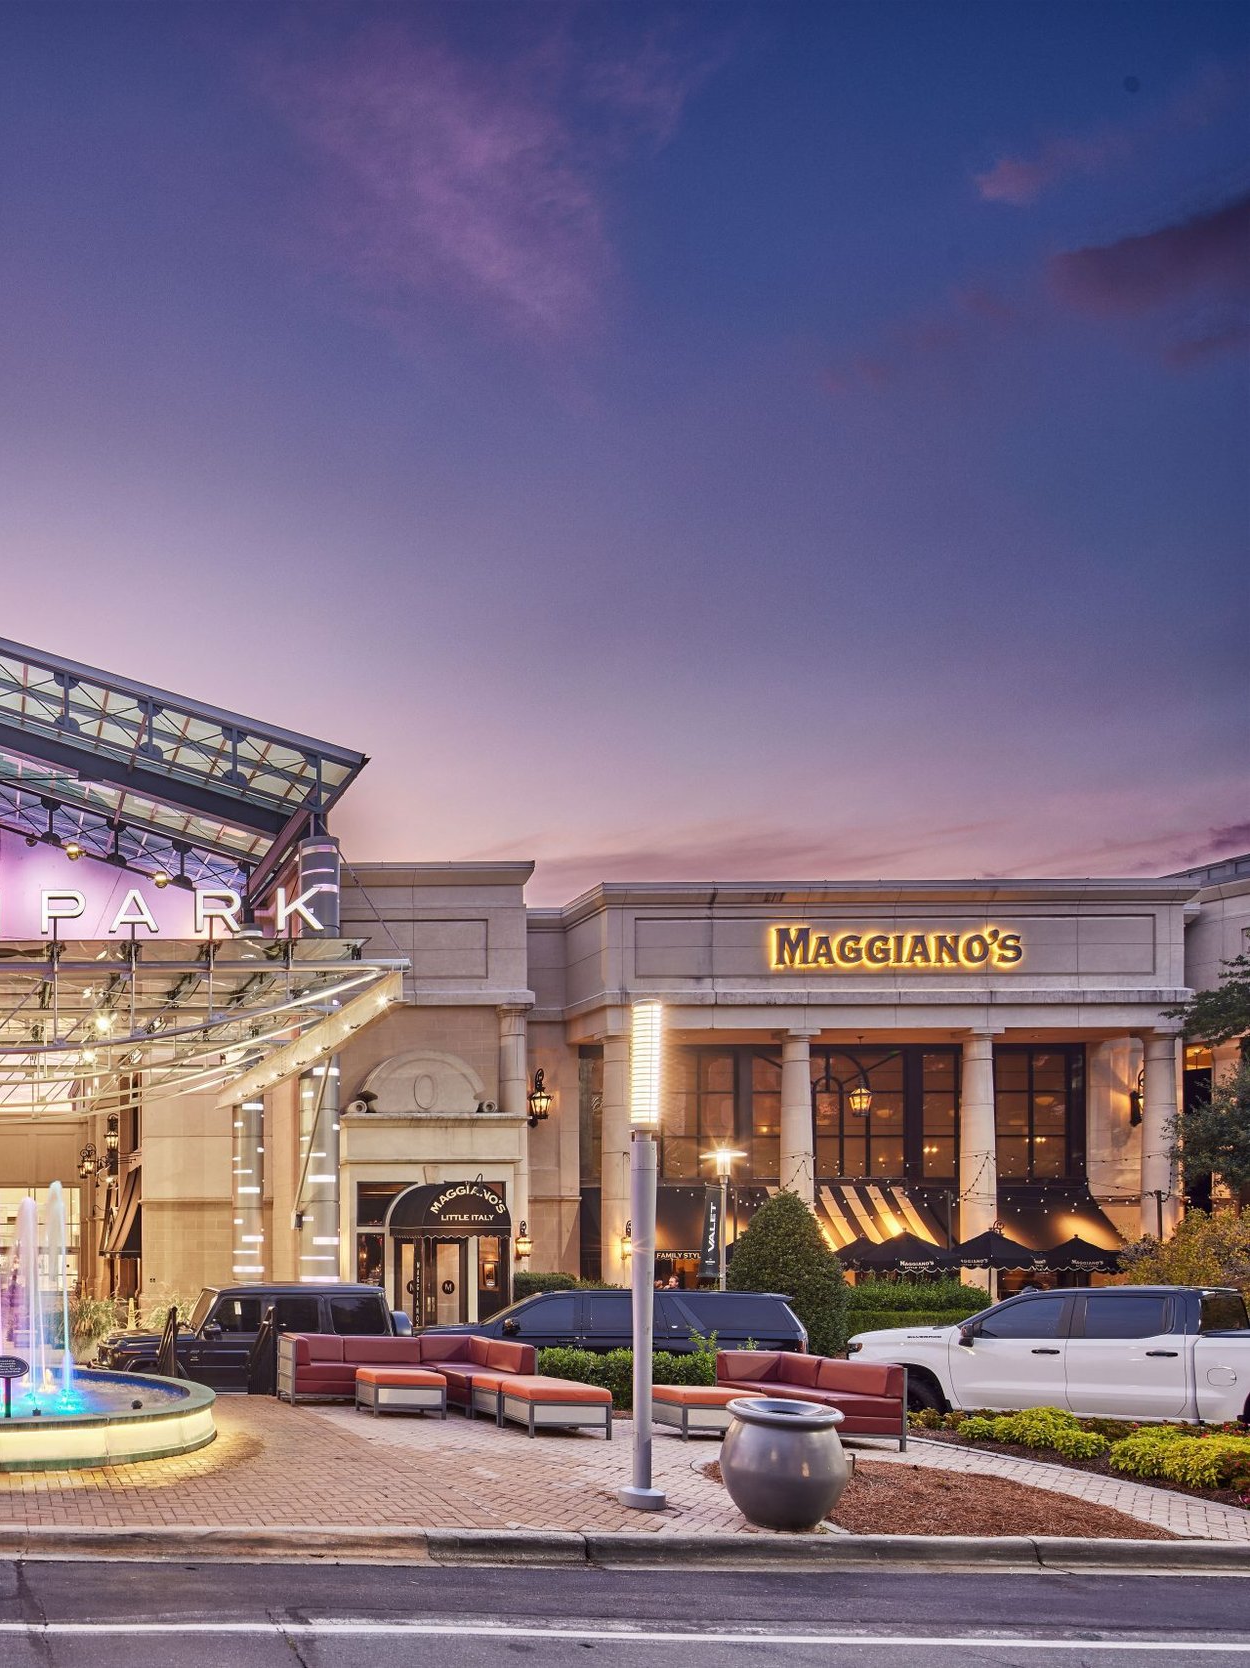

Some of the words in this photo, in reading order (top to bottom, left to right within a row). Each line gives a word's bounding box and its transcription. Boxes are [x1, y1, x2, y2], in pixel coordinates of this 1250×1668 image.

[774, 927, 1023, 966] MAGGIANO'S
[430, 1185, 506, 1214] MAGGIANO'S
[707, 1202, 717, 1252] VALET
